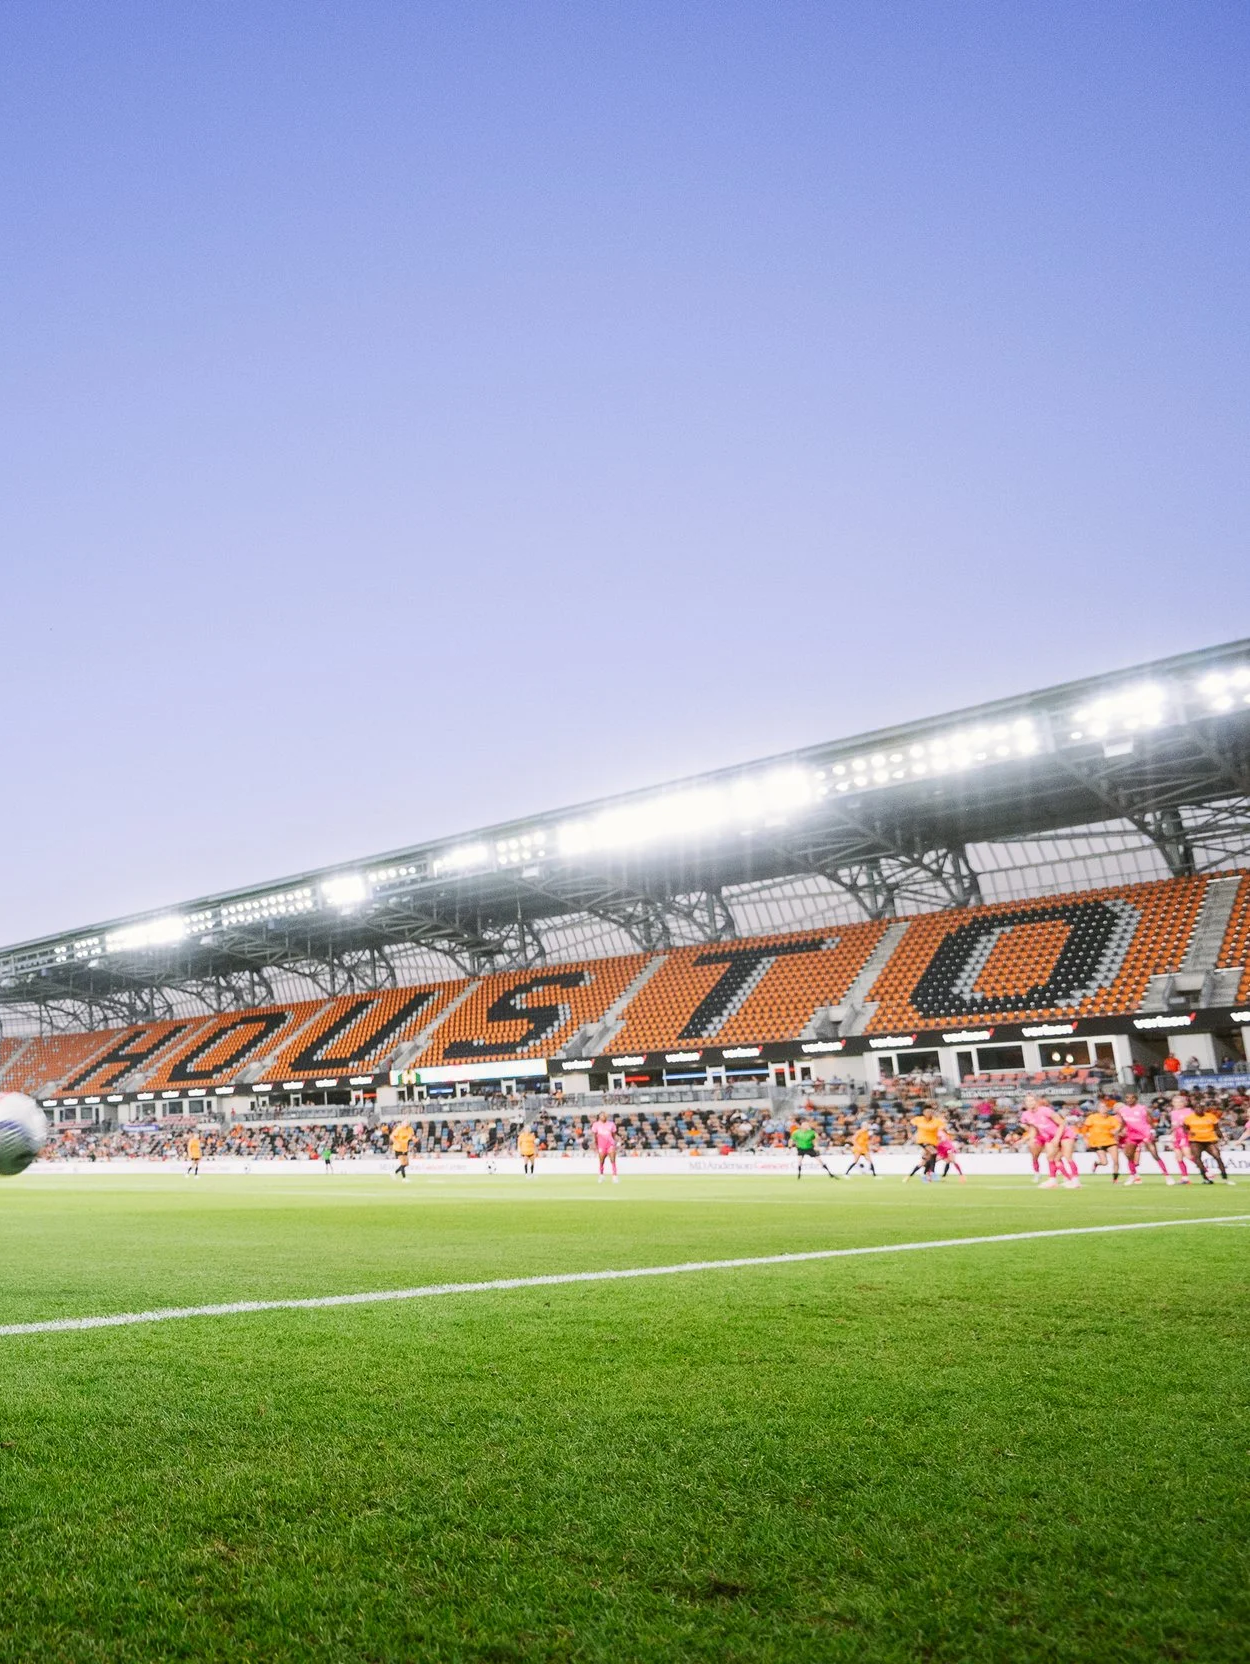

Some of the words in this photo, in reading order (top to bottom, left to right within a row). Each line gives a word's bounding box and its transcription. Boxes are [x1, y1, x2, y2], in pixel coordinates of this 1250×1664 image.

[1133, 1015, 1191, 1029] verizon
[942, 1030, 991, 1043] verizon
[1021, 1024, 1074, 1038] verizon
[801, 1041, 843, 1054] verizon
[868, 1035, 914, 1049] verizon
[707, 1161, 753, 1170] Anderson
